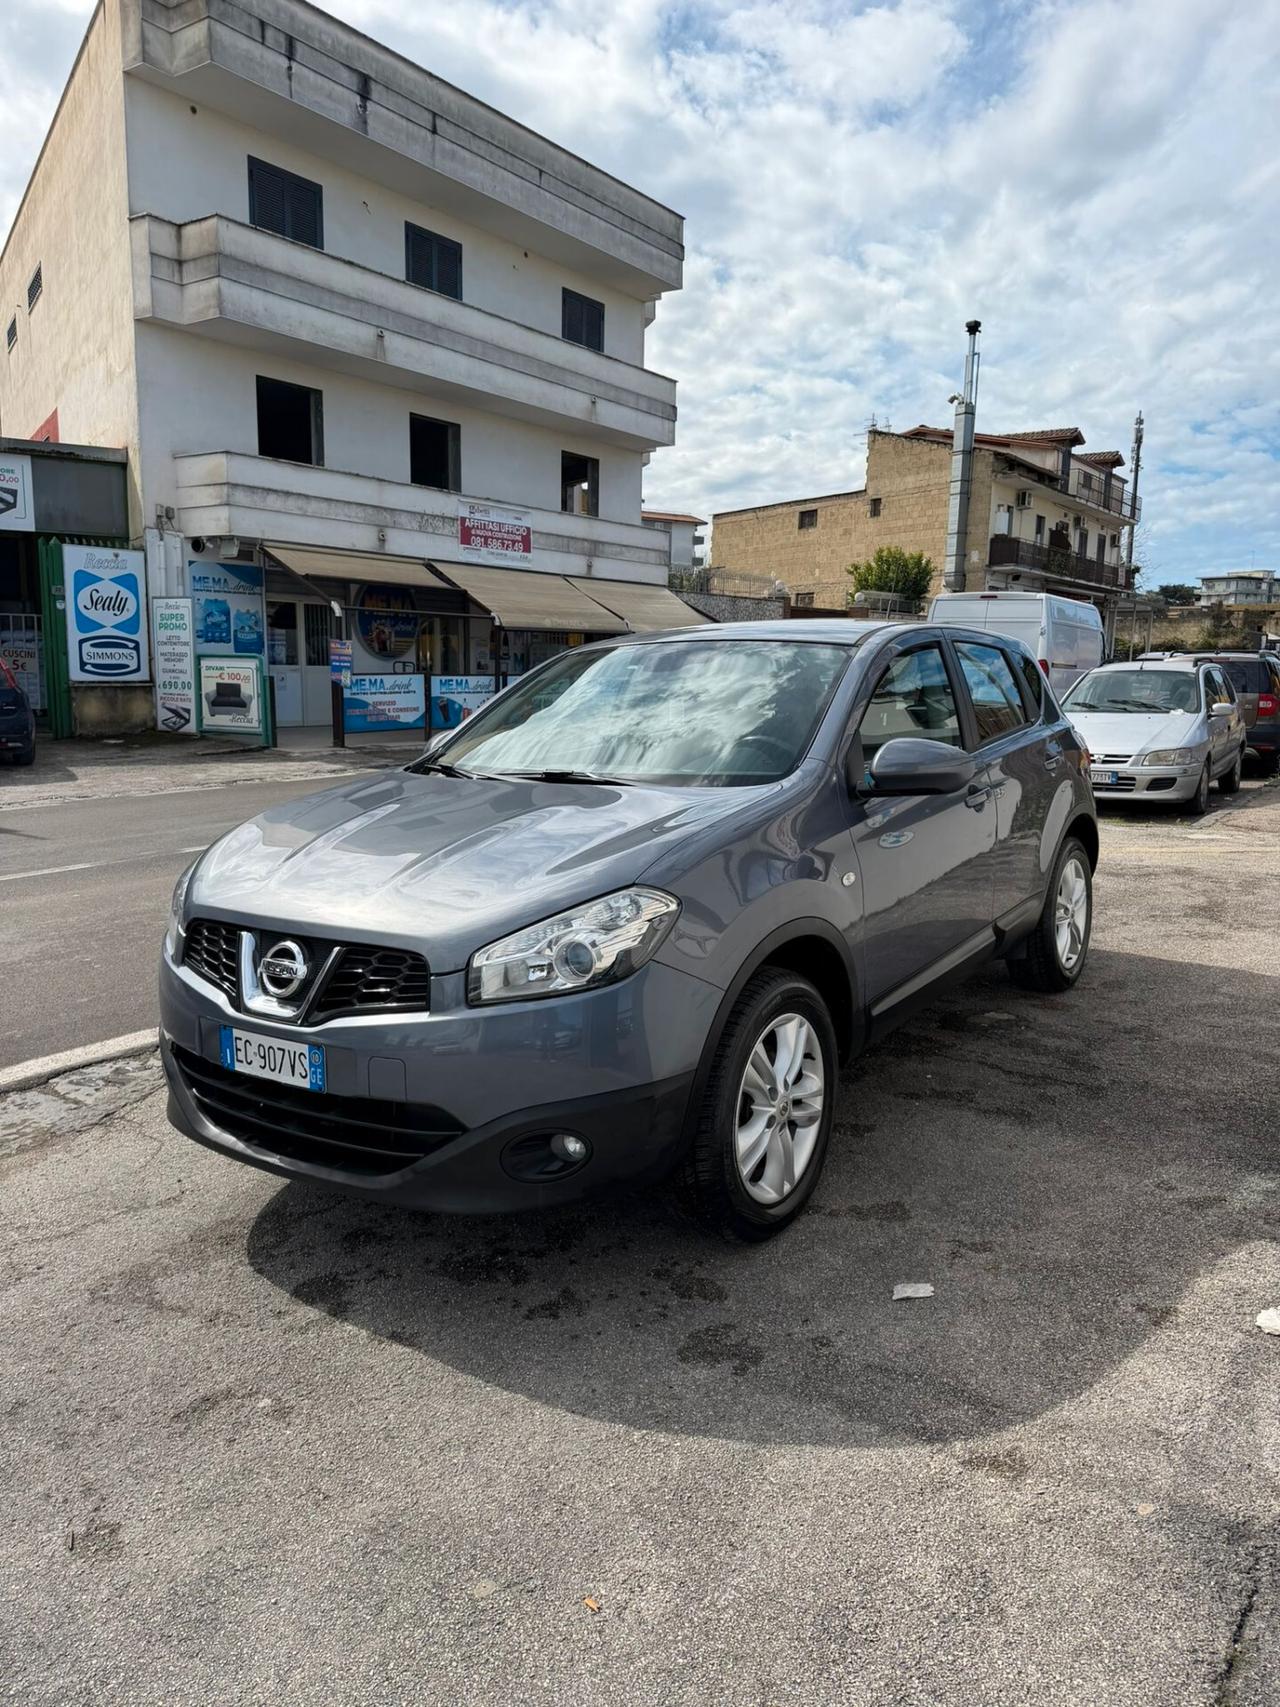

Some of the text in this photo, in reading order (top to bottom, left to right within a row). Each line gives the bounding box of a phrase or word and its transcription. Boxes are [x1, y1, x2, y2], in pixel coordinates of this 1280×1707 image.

[465, 518, 527, 535] AFFITTASI UFFICIO
[84, 588, 128, 616] Sealy
[160, 613, 185, 621] SUPER
[158, 622, 188, 631] PROMO
[86, 651, 134, 660] SIMMONS
[310, 1067, 322, 1085] GE
